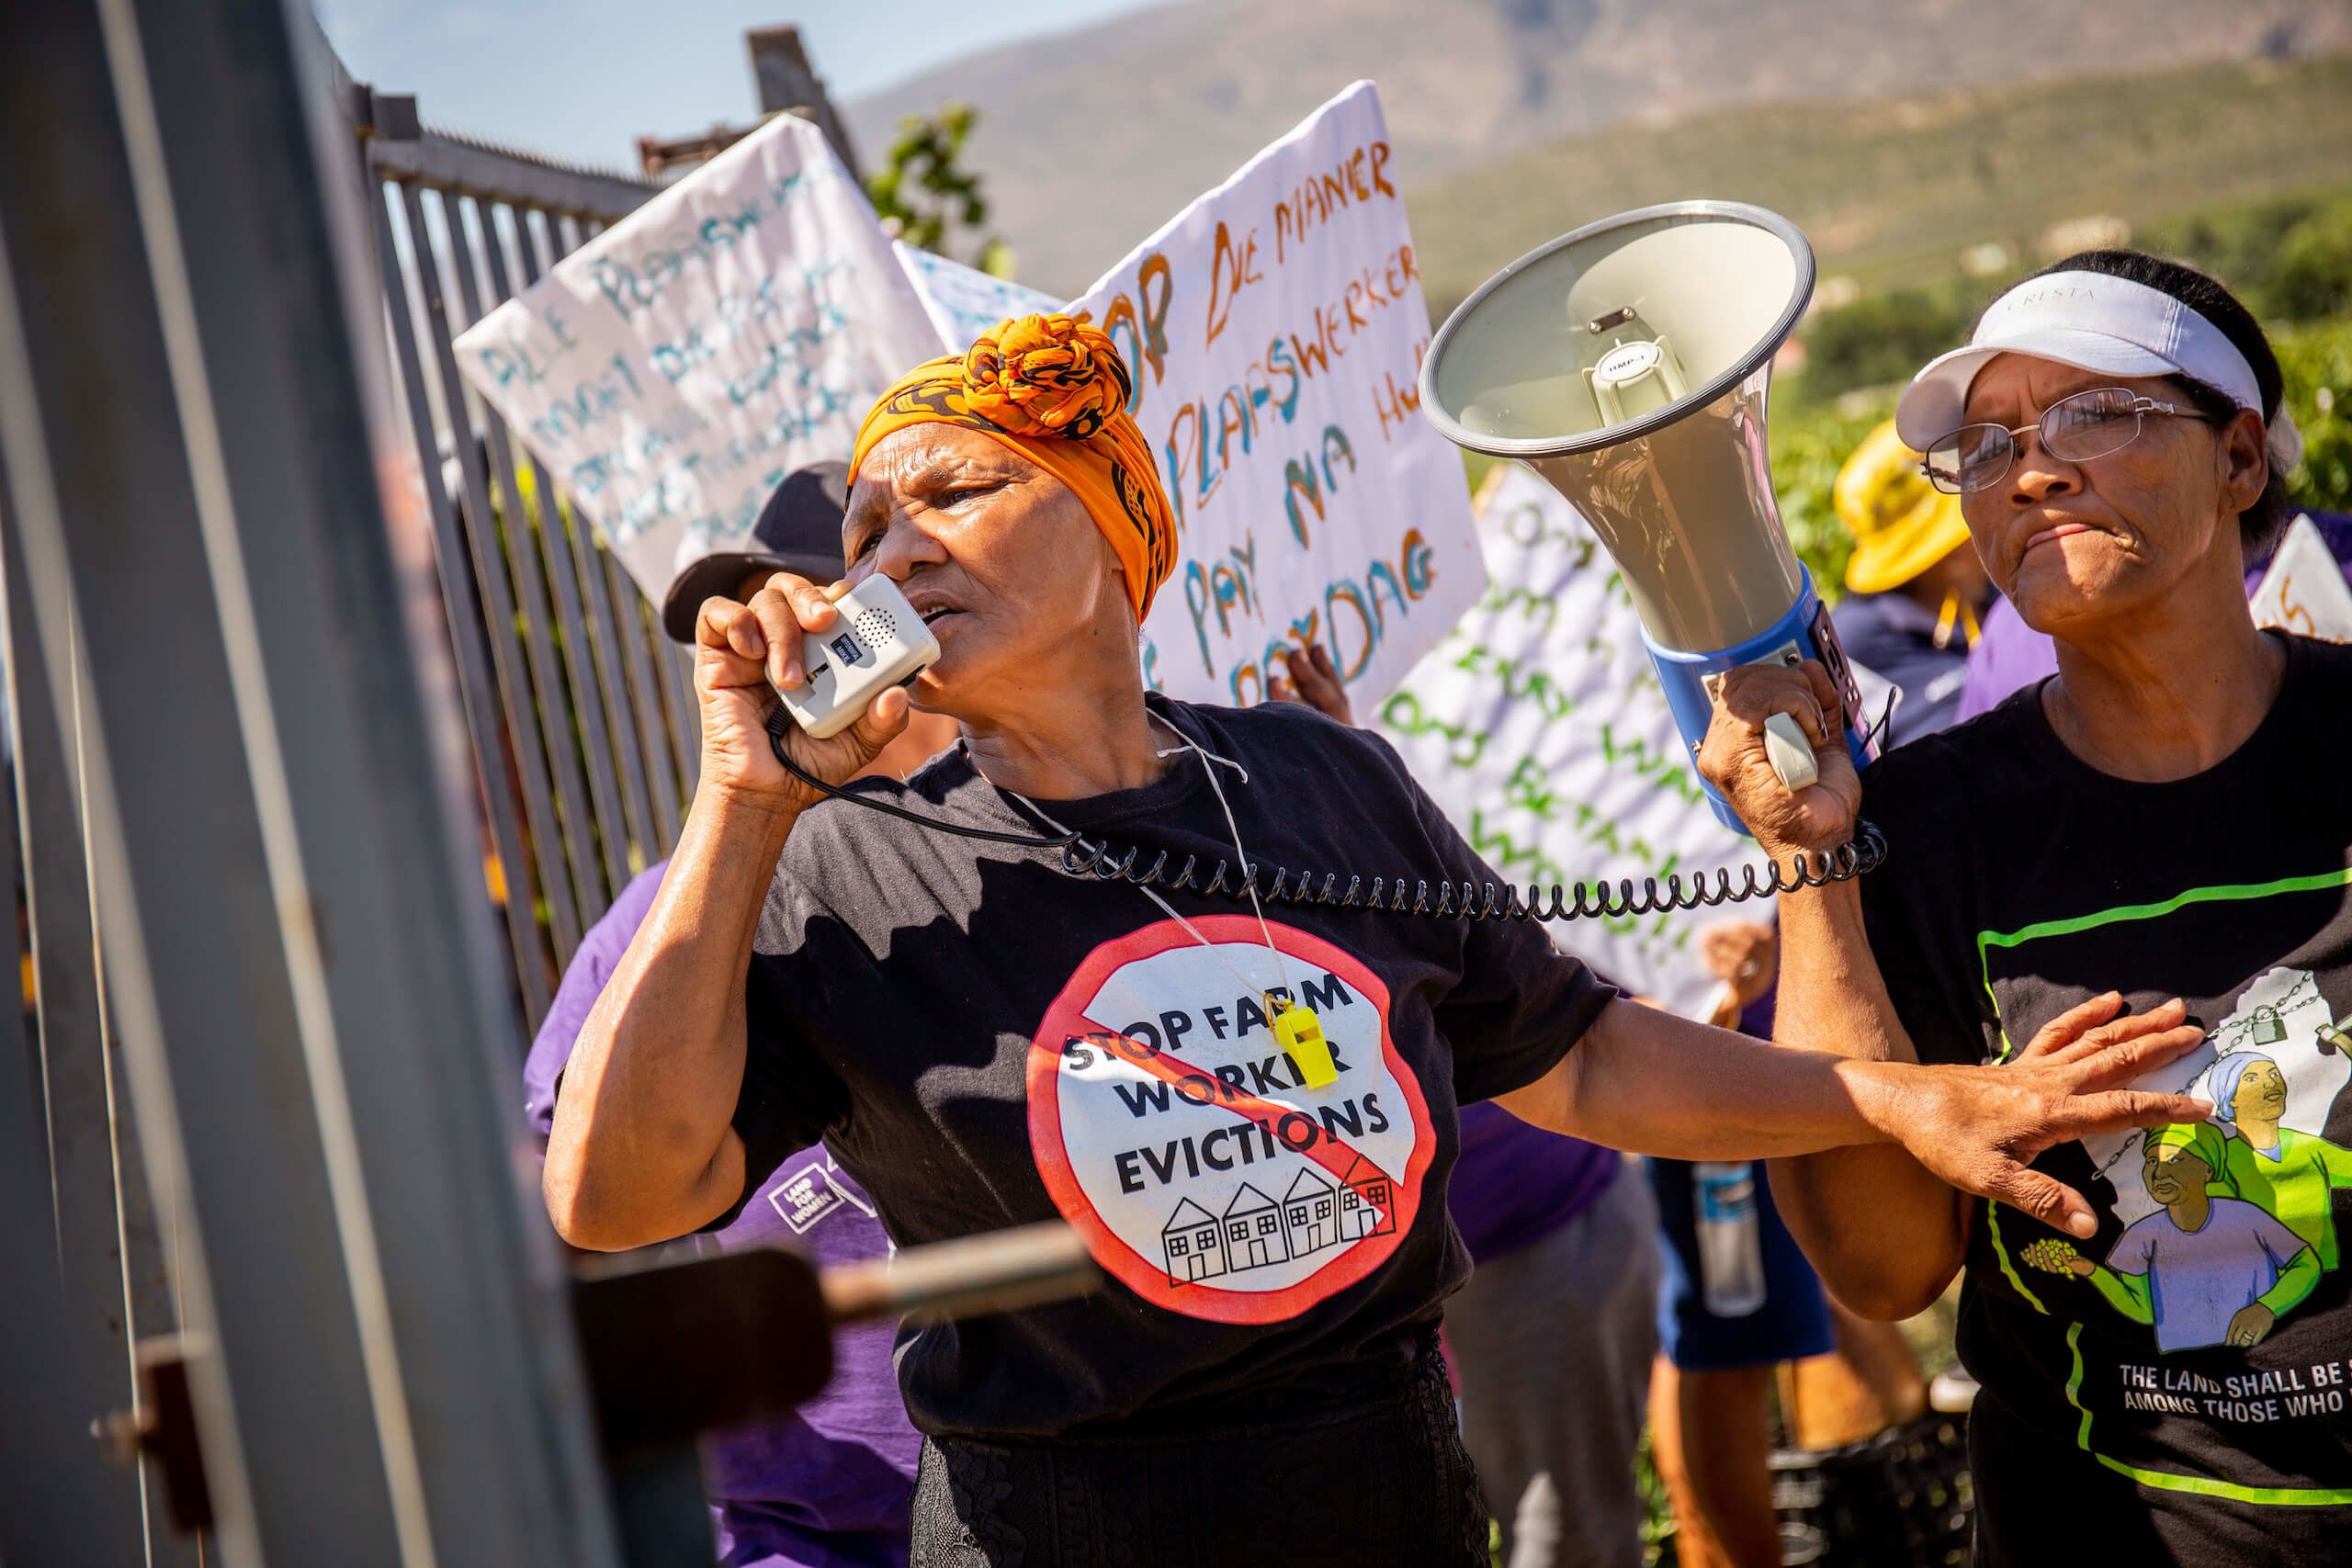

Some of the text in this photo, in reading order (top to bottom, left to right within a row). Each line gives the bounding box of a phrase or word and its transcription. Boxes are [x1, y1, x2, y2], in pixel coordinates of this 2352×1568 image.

[1206, 220, 1264, 353] DIE
[1274, 141, 1396, 265] MANIER
[1184, 528, 1265, 681] PAY
[1283, 424, 1356, 550] NA
[1063, 973, 1354, 1072] STOP FARM
[1114, 1092, 1390, 1195] EVICTIONS
[783, 1177, 813, 1203] LAND
[790, 1190, 834, 1224] WOMEN
[793, 1189, 817, 1210] FOR
[2119, 1363, 2158, 1390] THE
[2165, 1368, 2222, 1395] LAND
[2224, 1369, 2306, 1399] SHALL
[2310, 1361, 2344, 1388] BE
[2123, 1390, 2200, 1415] AMONG
[2202, 1398, 2281, 1424] THOSE
[2284, 1389, 2344, 1417] WHO
